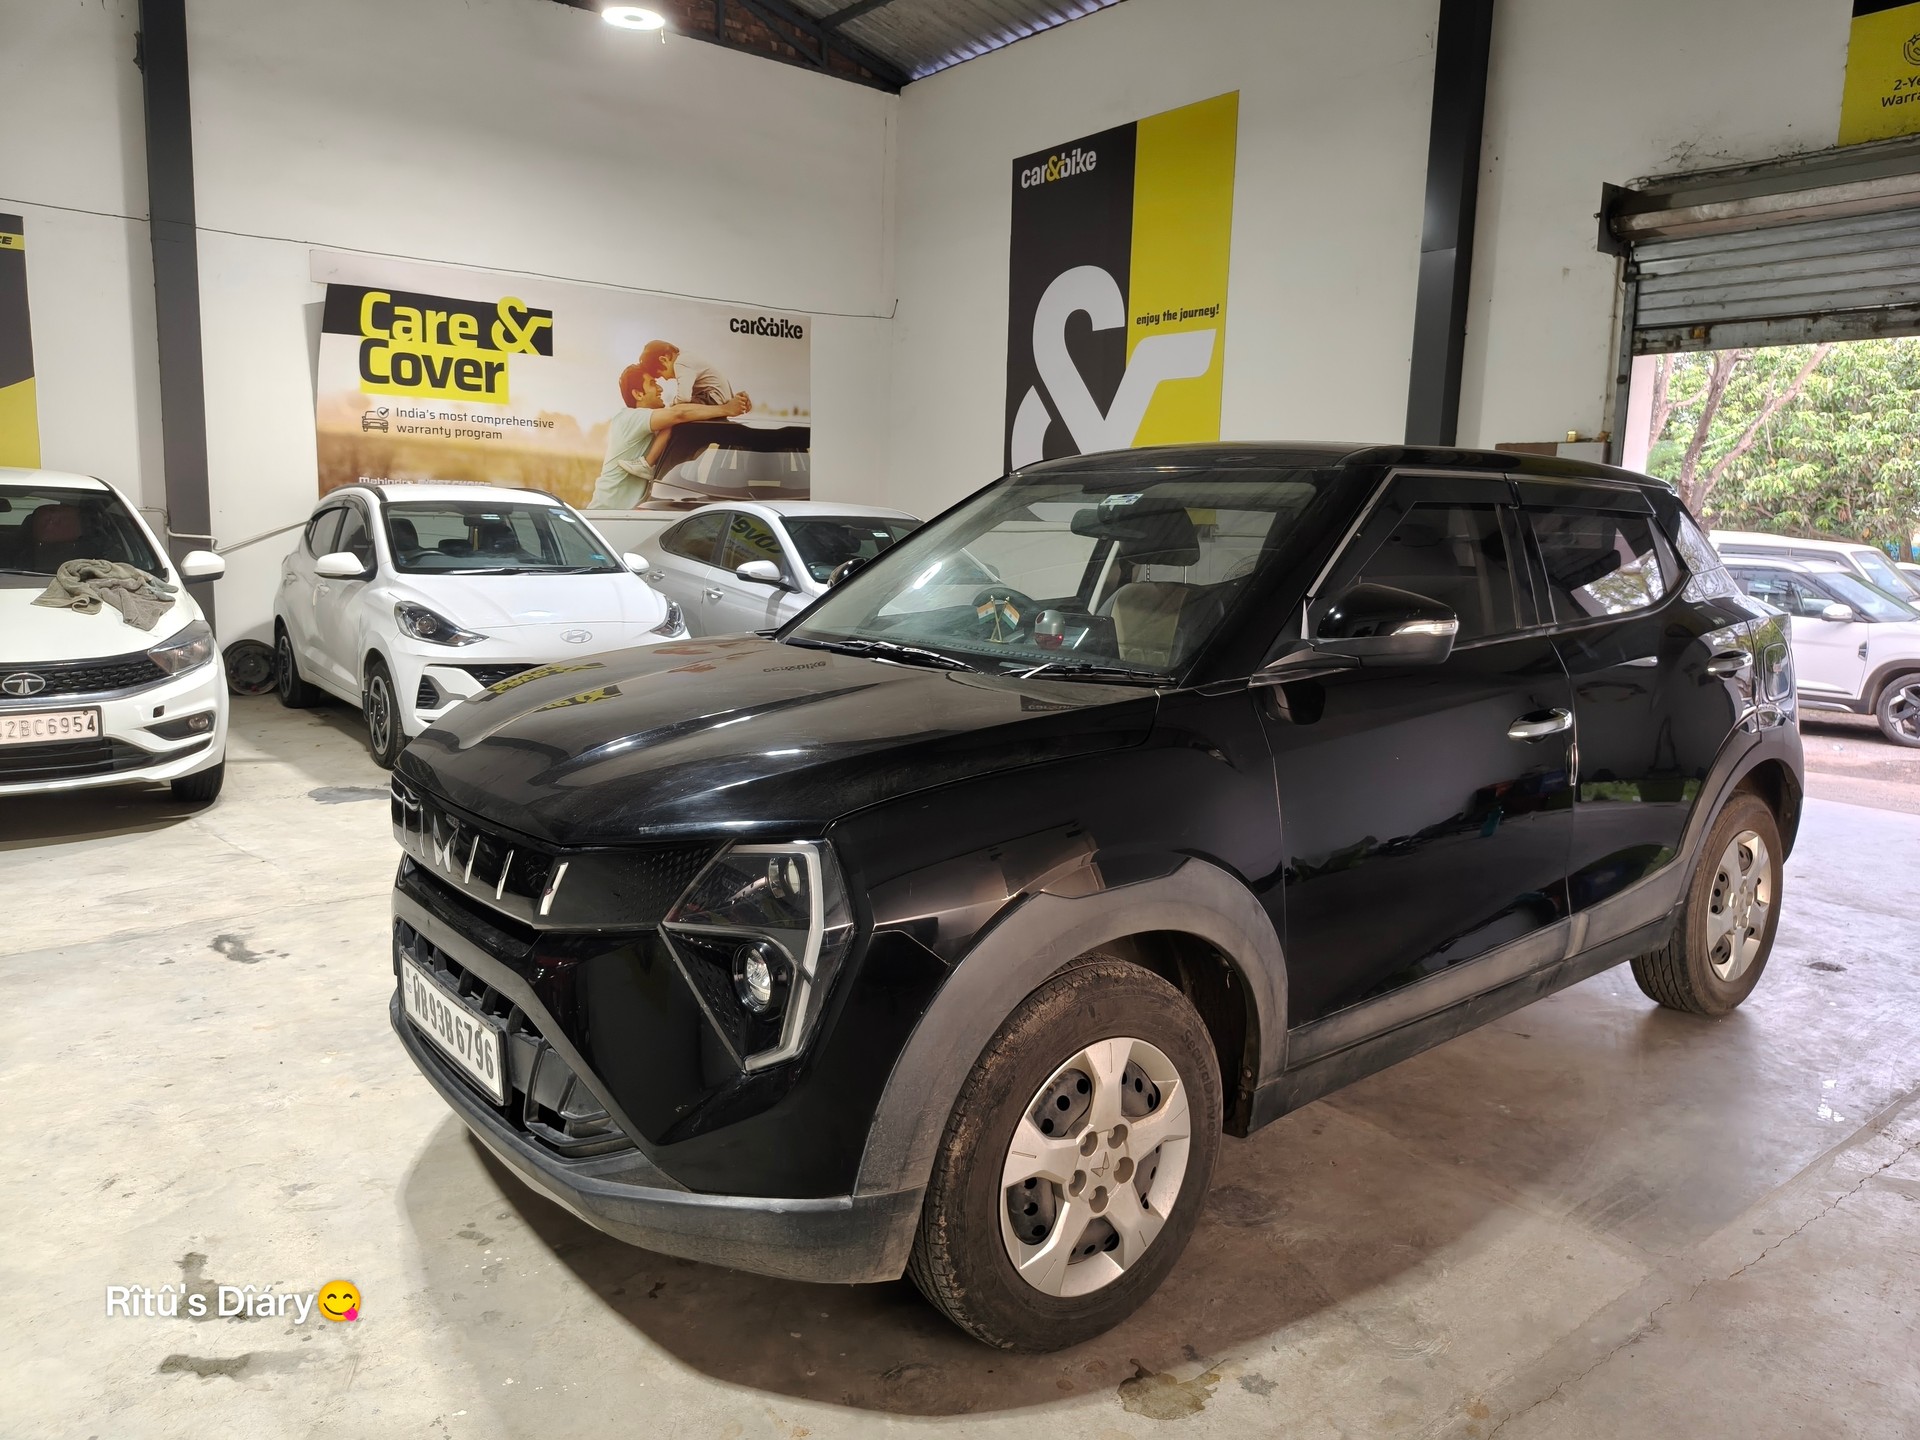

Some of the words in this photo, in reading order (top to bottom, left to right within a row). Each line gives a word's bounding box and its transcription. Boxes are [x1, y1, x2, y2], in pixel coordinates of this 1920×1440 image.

[1020, 147, 1097, 189] car&bike
[360, 291, 479, 348] Care
[491, 296, 553, 356] &
[1136, 312, 1161, 326] enjoy
[1162, 309, 1178, 322] the
[1179, 303, 1220, 322] journey!
[729, 316, 803, 340] car&bike
[358, 337, 505, 394] Cover
[396, 407, 436, 420] India's
[439, 411, 468, 422] most
[471, 414, 555, 429] comprehensive
[396, 424, 451, 439] warranty
[454, 427, 503, 440] program
[0, 715, 96, 739] 2BC6954
[412, 974, 495, 1080] WB93B6796
